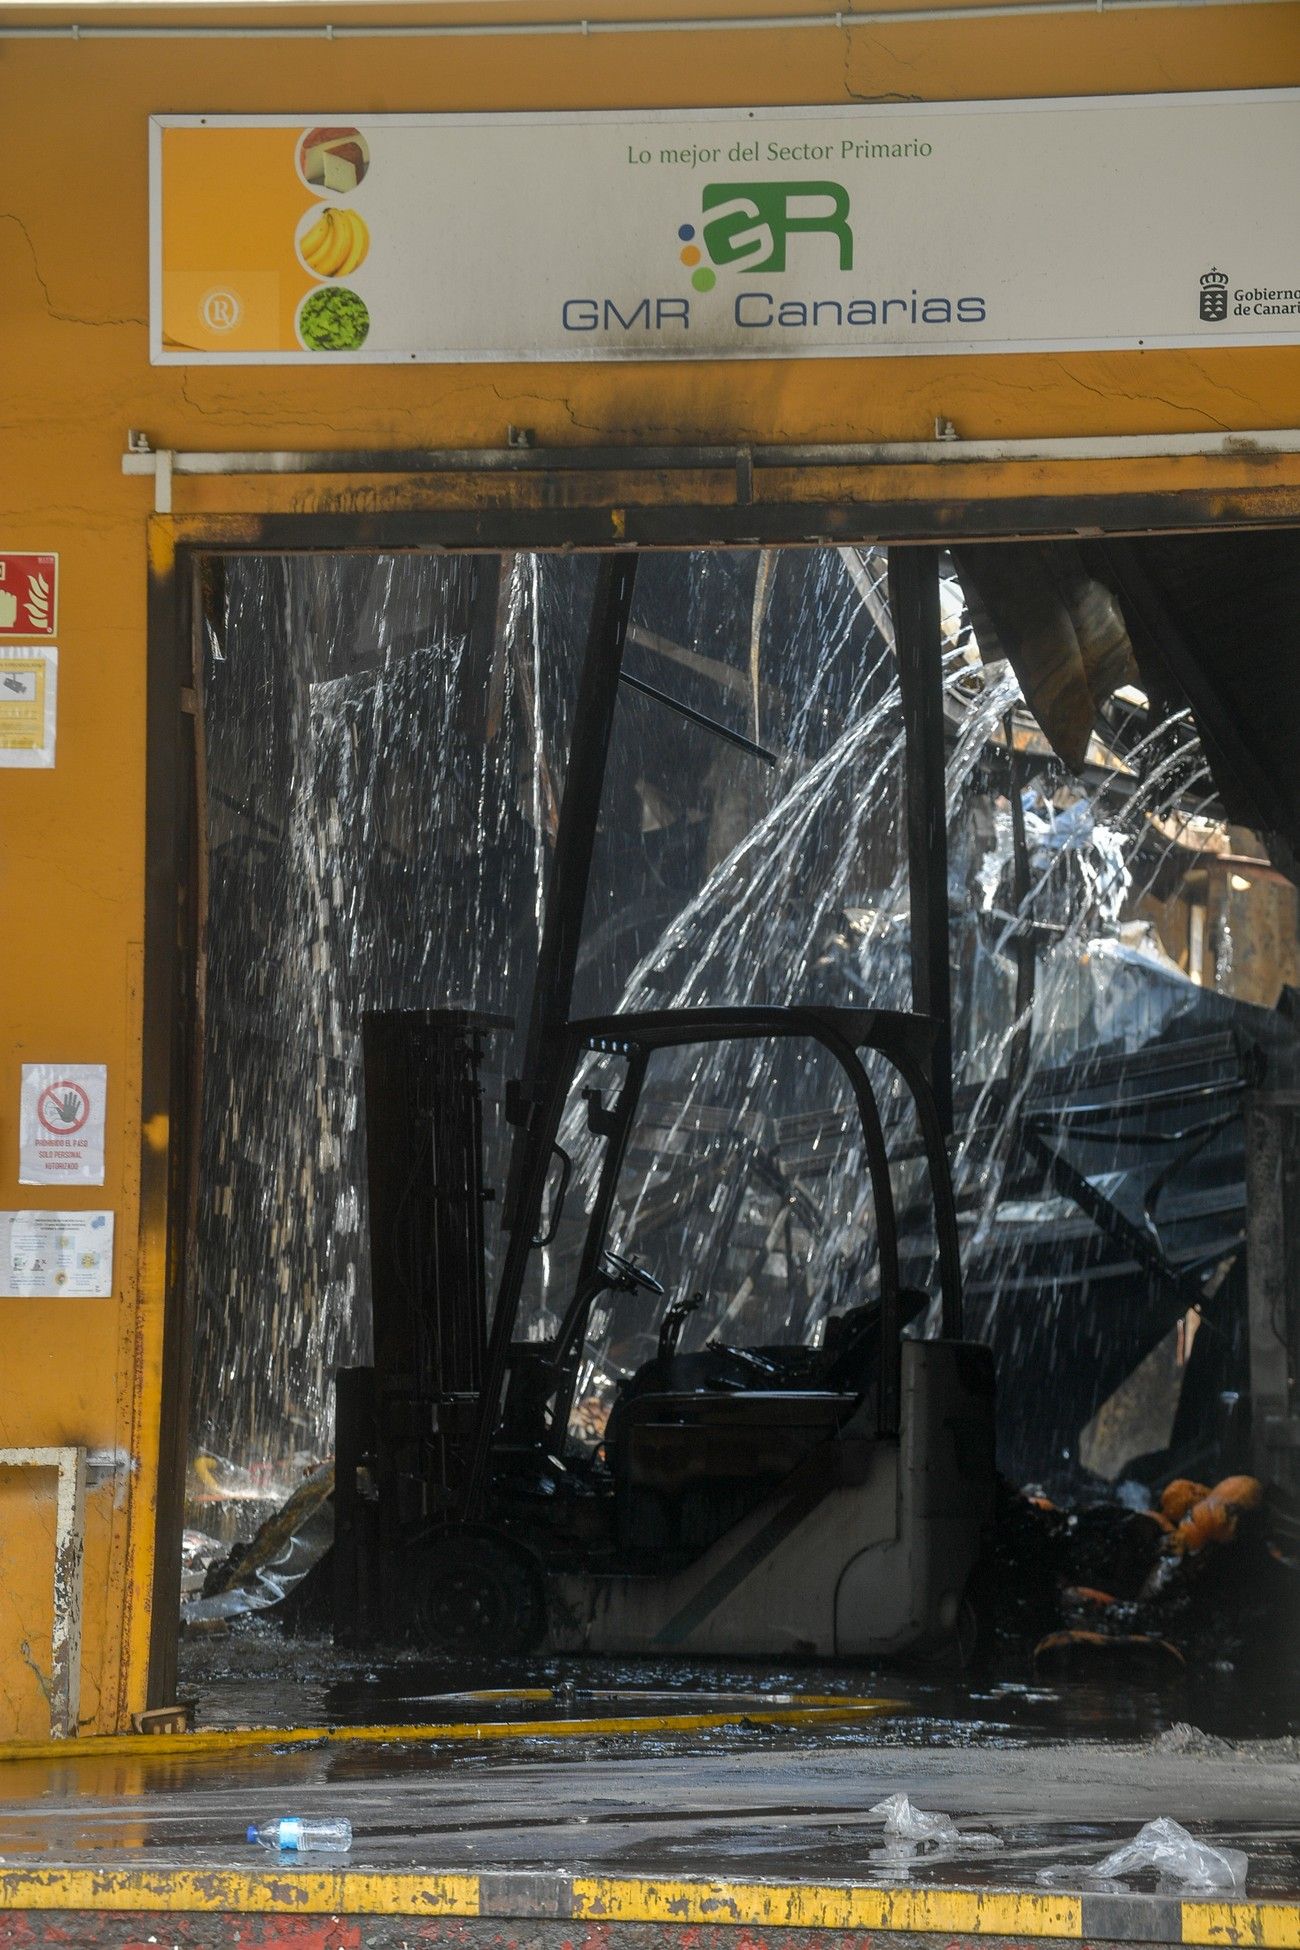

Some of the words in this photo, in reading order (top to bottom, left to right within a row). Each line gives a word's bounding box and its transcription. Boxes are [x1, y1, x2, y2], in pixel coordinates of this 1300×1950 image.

[628, 145, 651, 164] Lo
[660, 144, 721, 169] mejor
[728, 141, 759, 162] del
[767, 141, 834, 161] Sector
[841, 138, 933, 159] Primario
[562, 299, 690, 331] GMR
[734, 290, 987, 328] Canarias
[1233, 303, 1251, 316] de
[73, 1139, 89, 1148] PASO
[38, 1151, 53, 1159] SOLO
[54, 1151, 82, 1159] PERSONAL
